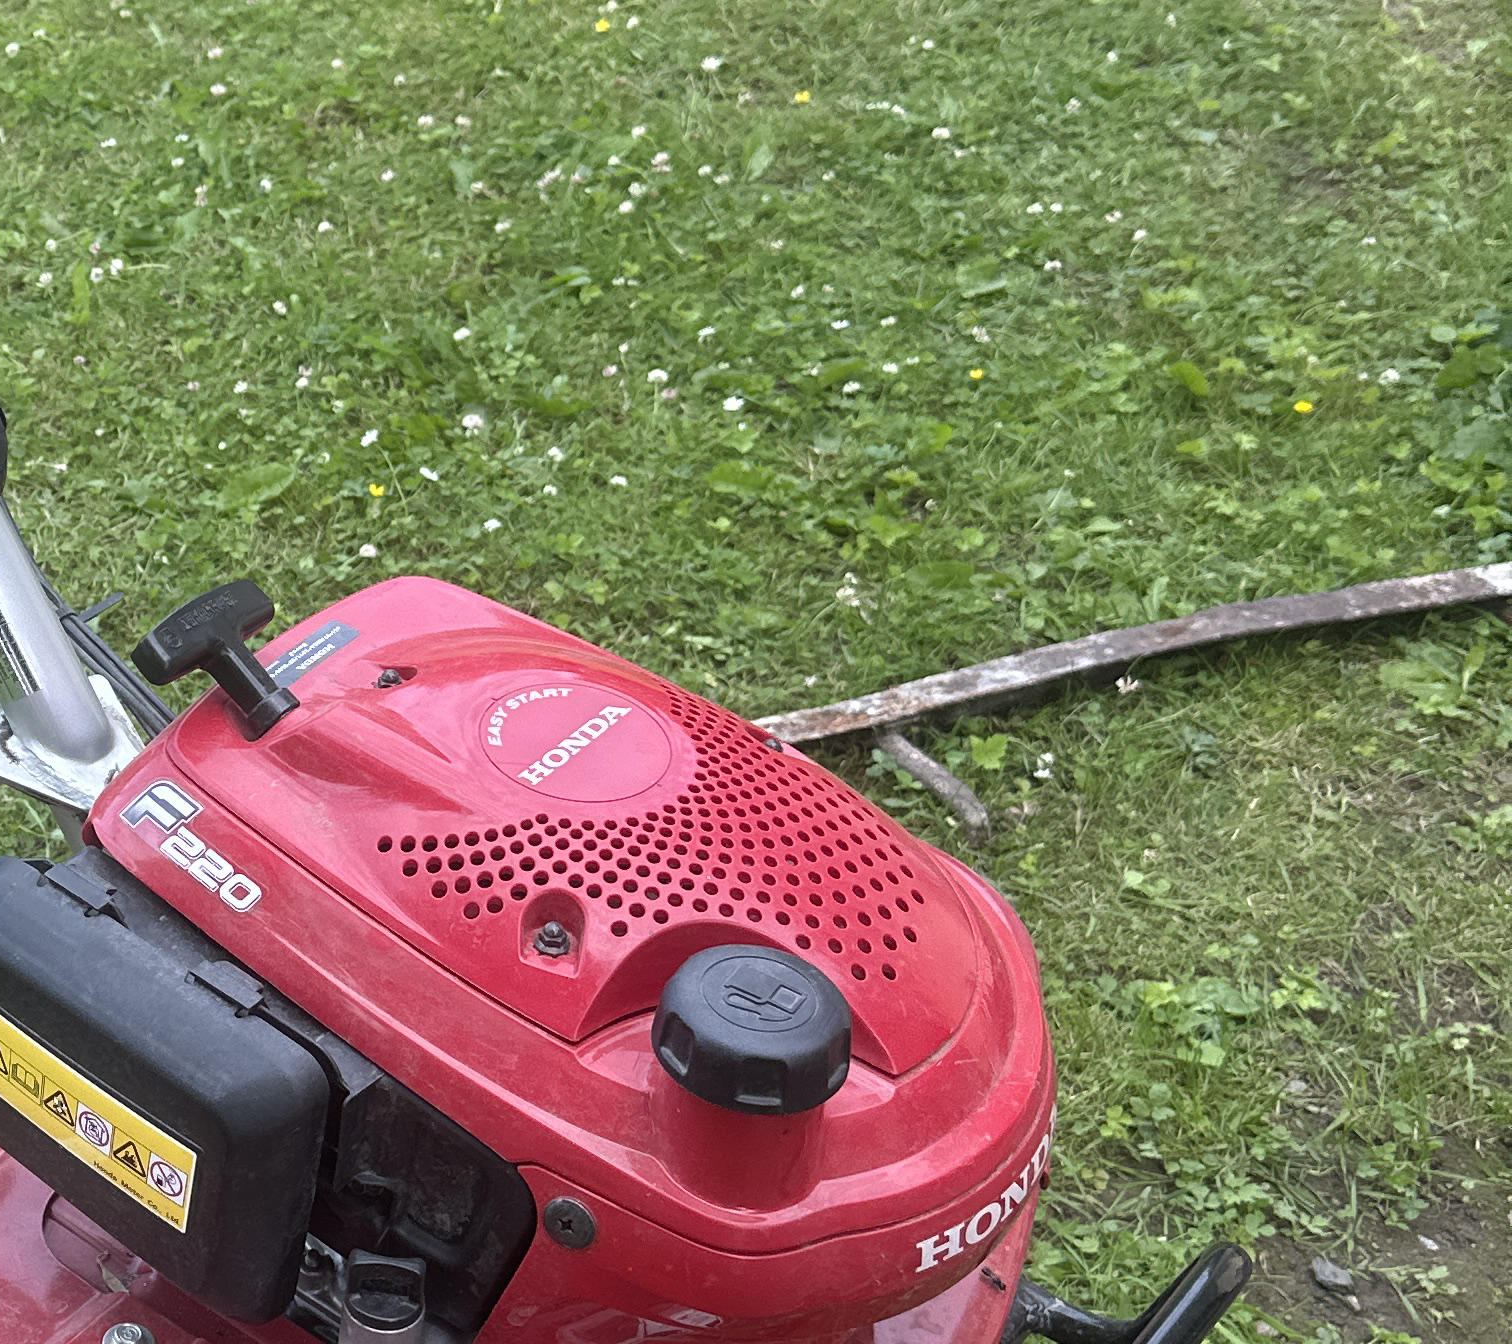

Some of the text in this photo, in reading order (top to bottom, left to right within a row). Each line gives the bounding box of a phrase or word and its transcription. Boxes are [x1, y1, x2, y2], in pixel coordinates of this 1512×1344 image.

[487, 687, 574, 747] EASY START
[517, 705, 633, 786] HONDA
